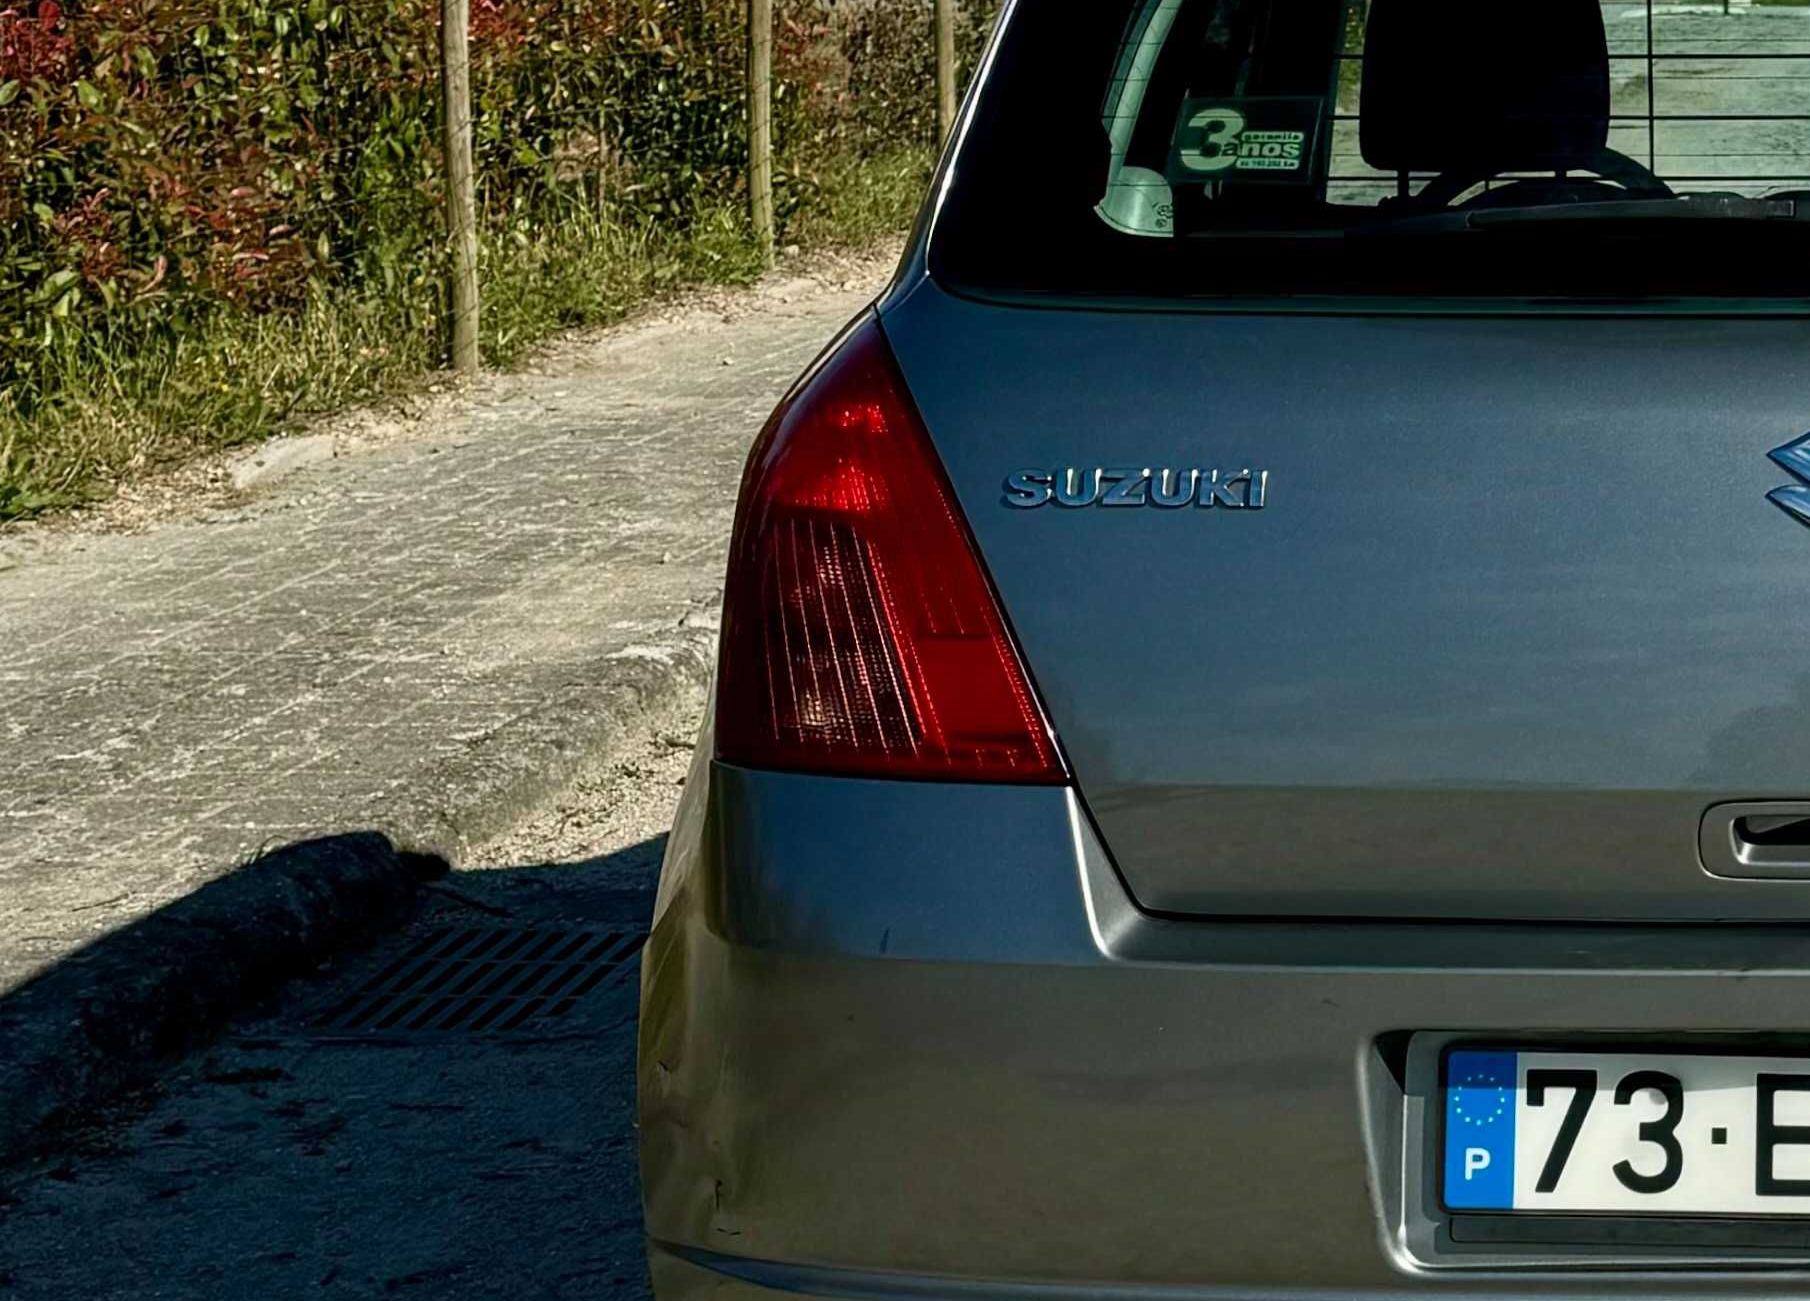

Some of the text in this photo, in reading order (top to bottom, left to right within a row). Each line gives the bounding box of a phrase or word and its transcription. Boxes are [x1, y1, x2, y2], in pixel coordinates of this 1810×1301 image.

[1180, 108, 1301, 171] 3 anos
[1001, 467, 1269, 509] SUZUKI
[1464, 1147, 1491, 1181] P
